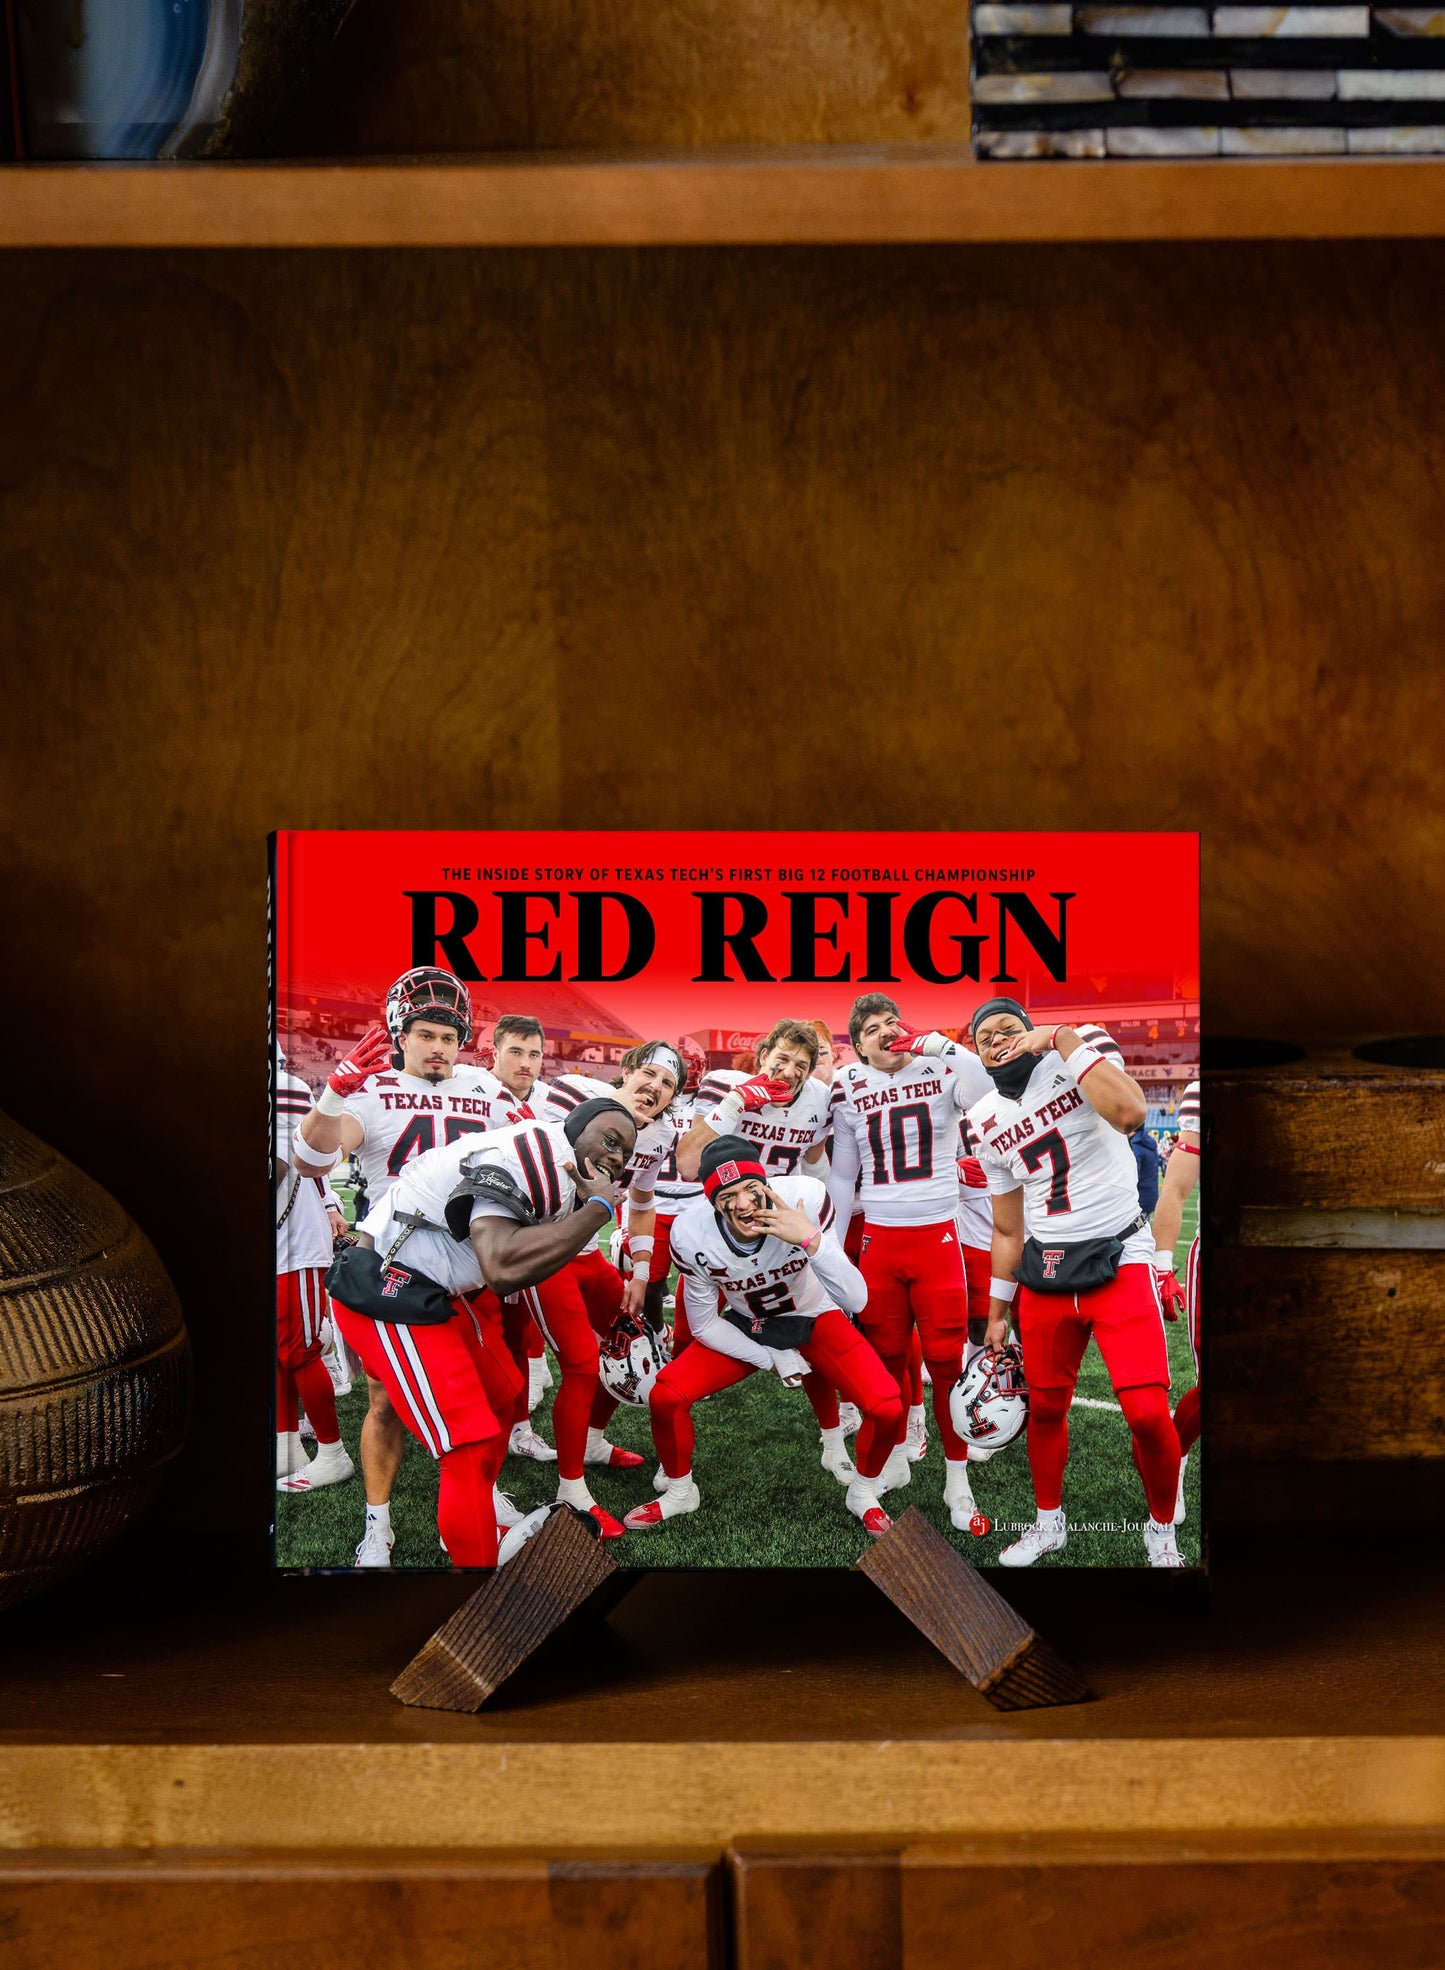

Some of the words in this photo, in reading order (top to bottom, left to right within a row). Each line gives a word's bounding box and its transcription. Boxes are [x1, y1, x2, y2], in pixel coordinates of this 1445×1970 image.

[441, 867, 472, 881] THE
[477, 867, 529, 881] INSIDE
[534, 867, 584, 881] STORY
[589, 867, 609, 881] OF
[614, 867, 665, 882] TEXAS
[729, 868, 773, 882] FIRST
[777, 868, 804, 882] BIG
[809, 868, 826, 882] 12
[831, 868, 910, 882] FOOTBALL
[914, 868, 1036, 882] CHAMPIONSHIP
[402, 891, 656, 982] RED
[691, 890, 1076, 984] REIGN
[379, 1093, 443, 1110] TEXAS
[448, 1096, 492, 1118] TECH
[853, 1087, 899, 1113] TEXAS
[902, 1079, 943, 1100] TECH
[990, 1117, 1035, 1155] TEXAS
[1034, 1087, 1084, 1127] TECH
[741, 1120, 786, 1142] TEXAS
[789, 1129, 818, 1144] TECH
[866, 1101, 933, 1185] 10
[1018, 1127, 1071, 1216] 7
